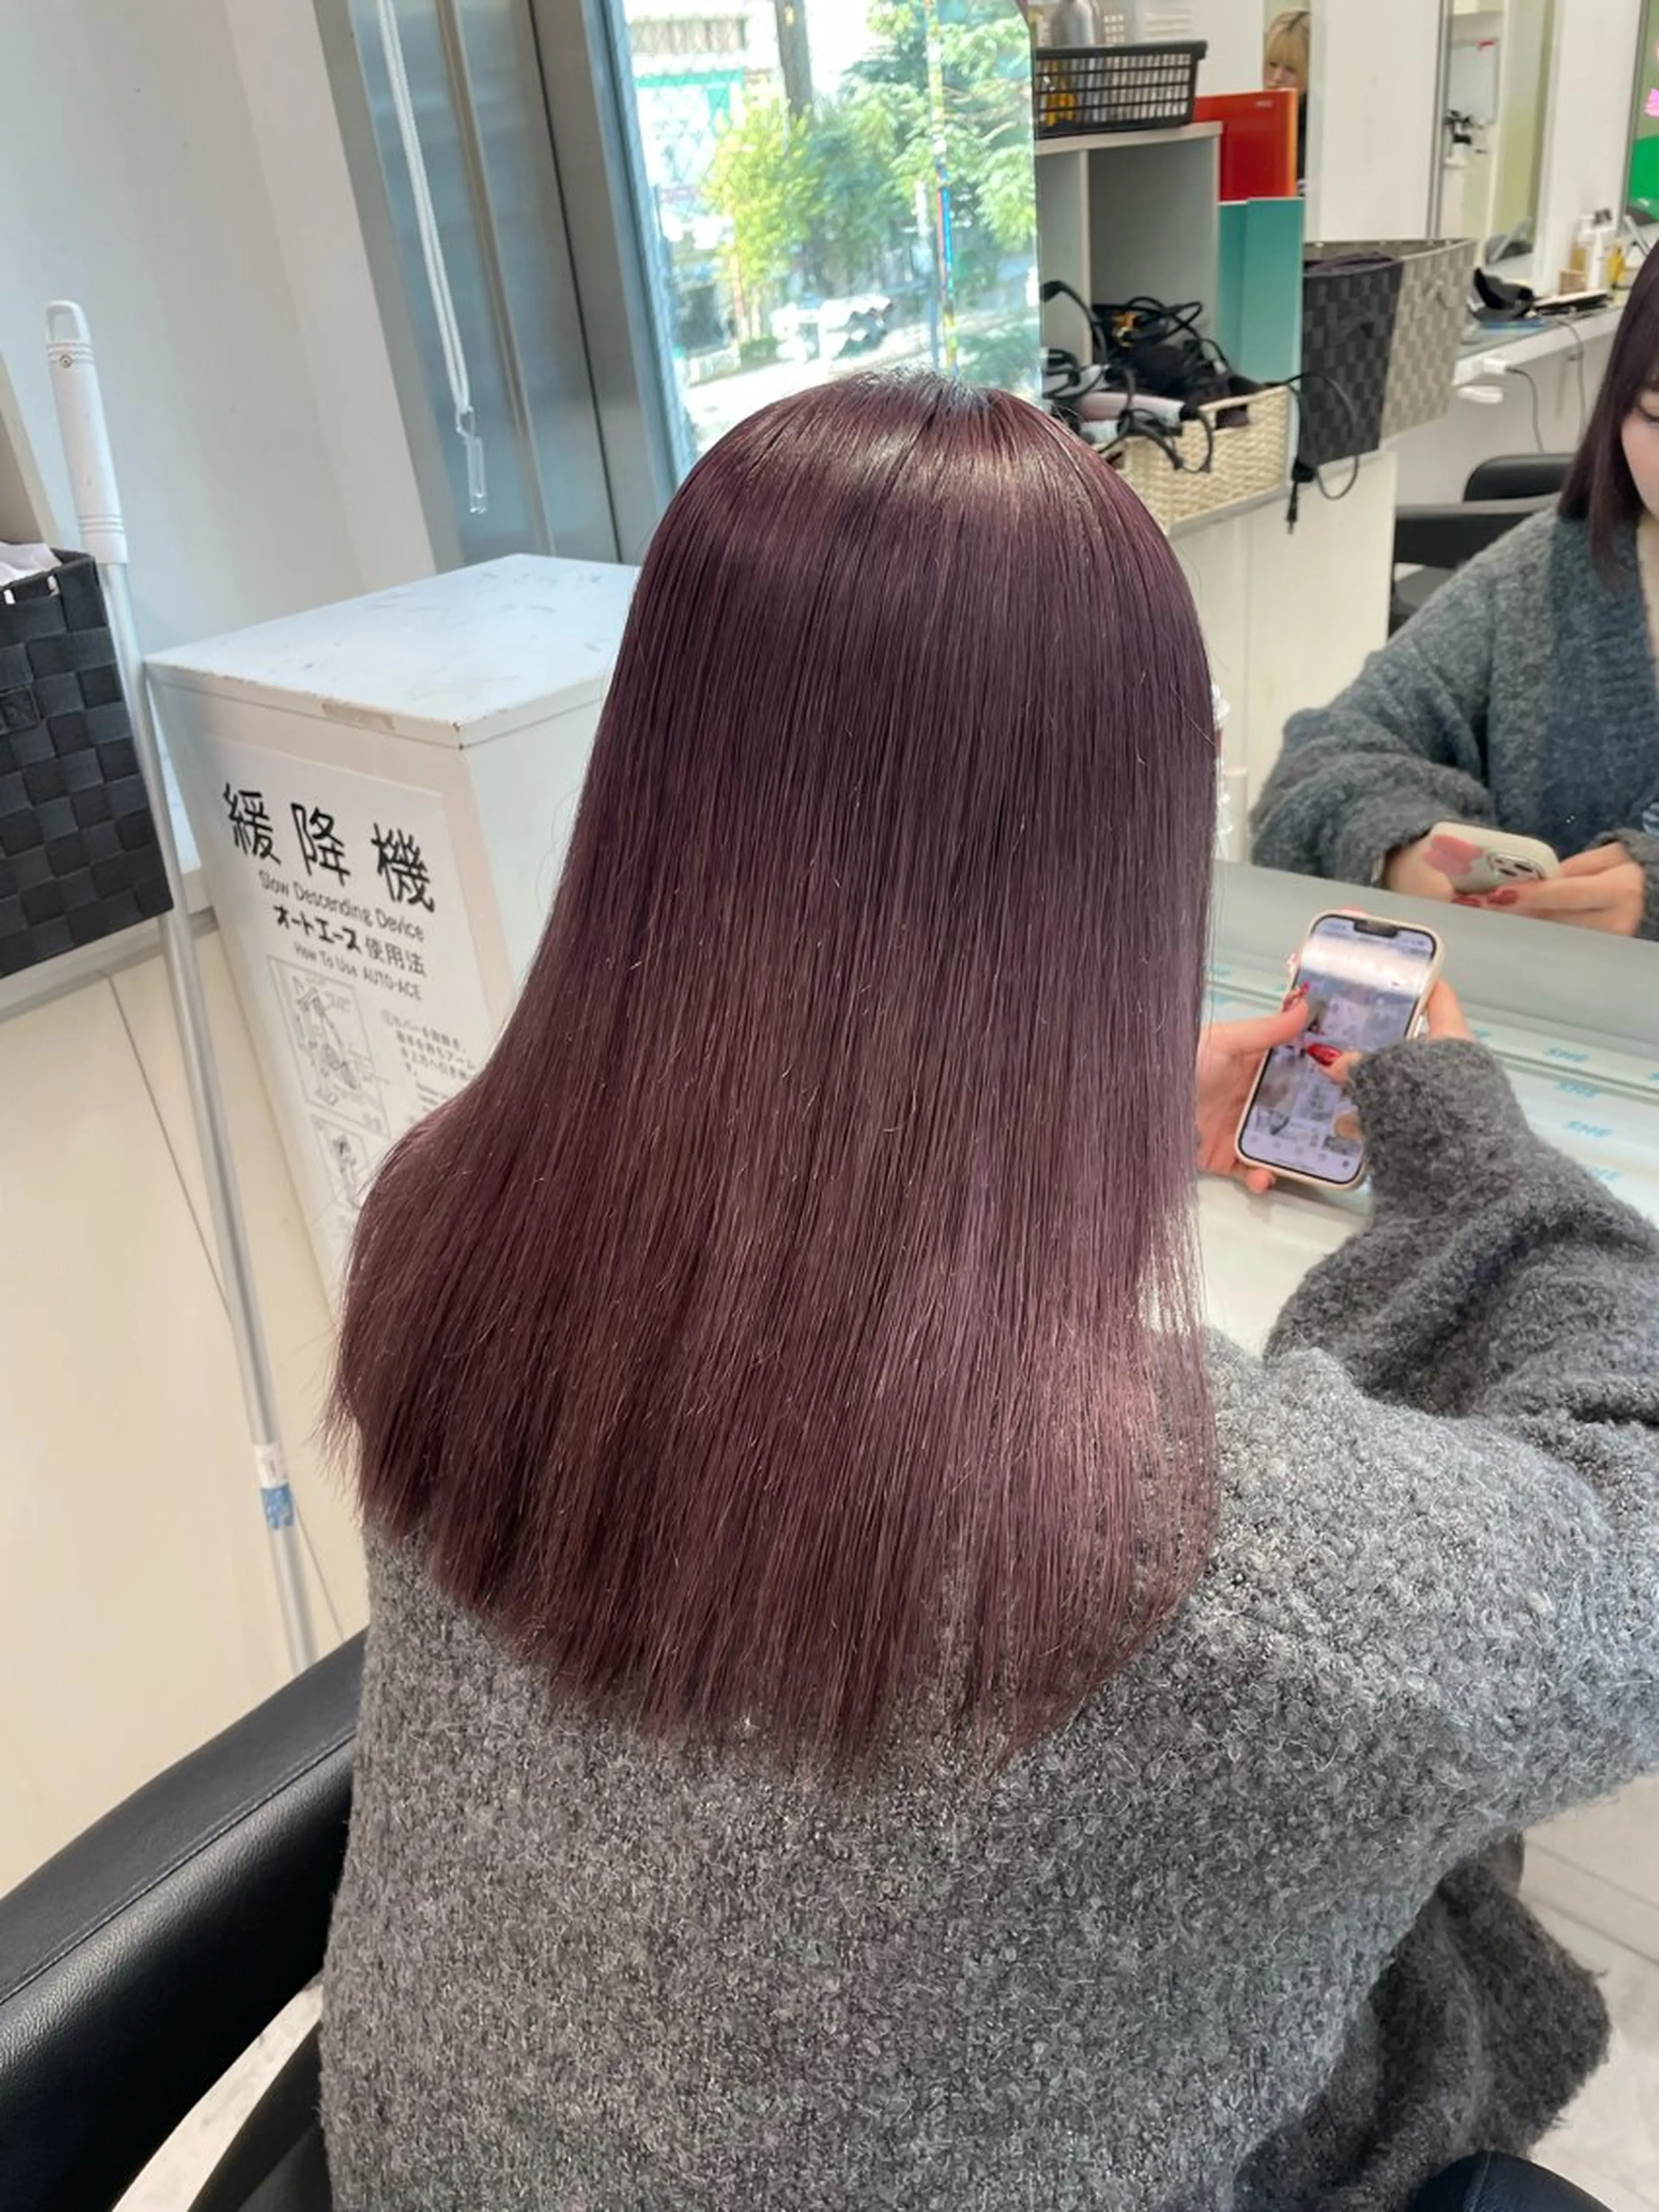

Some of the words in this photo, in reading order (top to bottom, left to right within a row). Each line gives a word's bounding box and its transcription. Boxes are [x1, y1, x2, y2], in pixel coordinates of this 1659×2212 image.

[223, 783, 435, 912] 緩降機
[259, 870, 289, 896] Slow
[293, 881, 373, 927] Descending
[375, 907, 425, 942] Device
